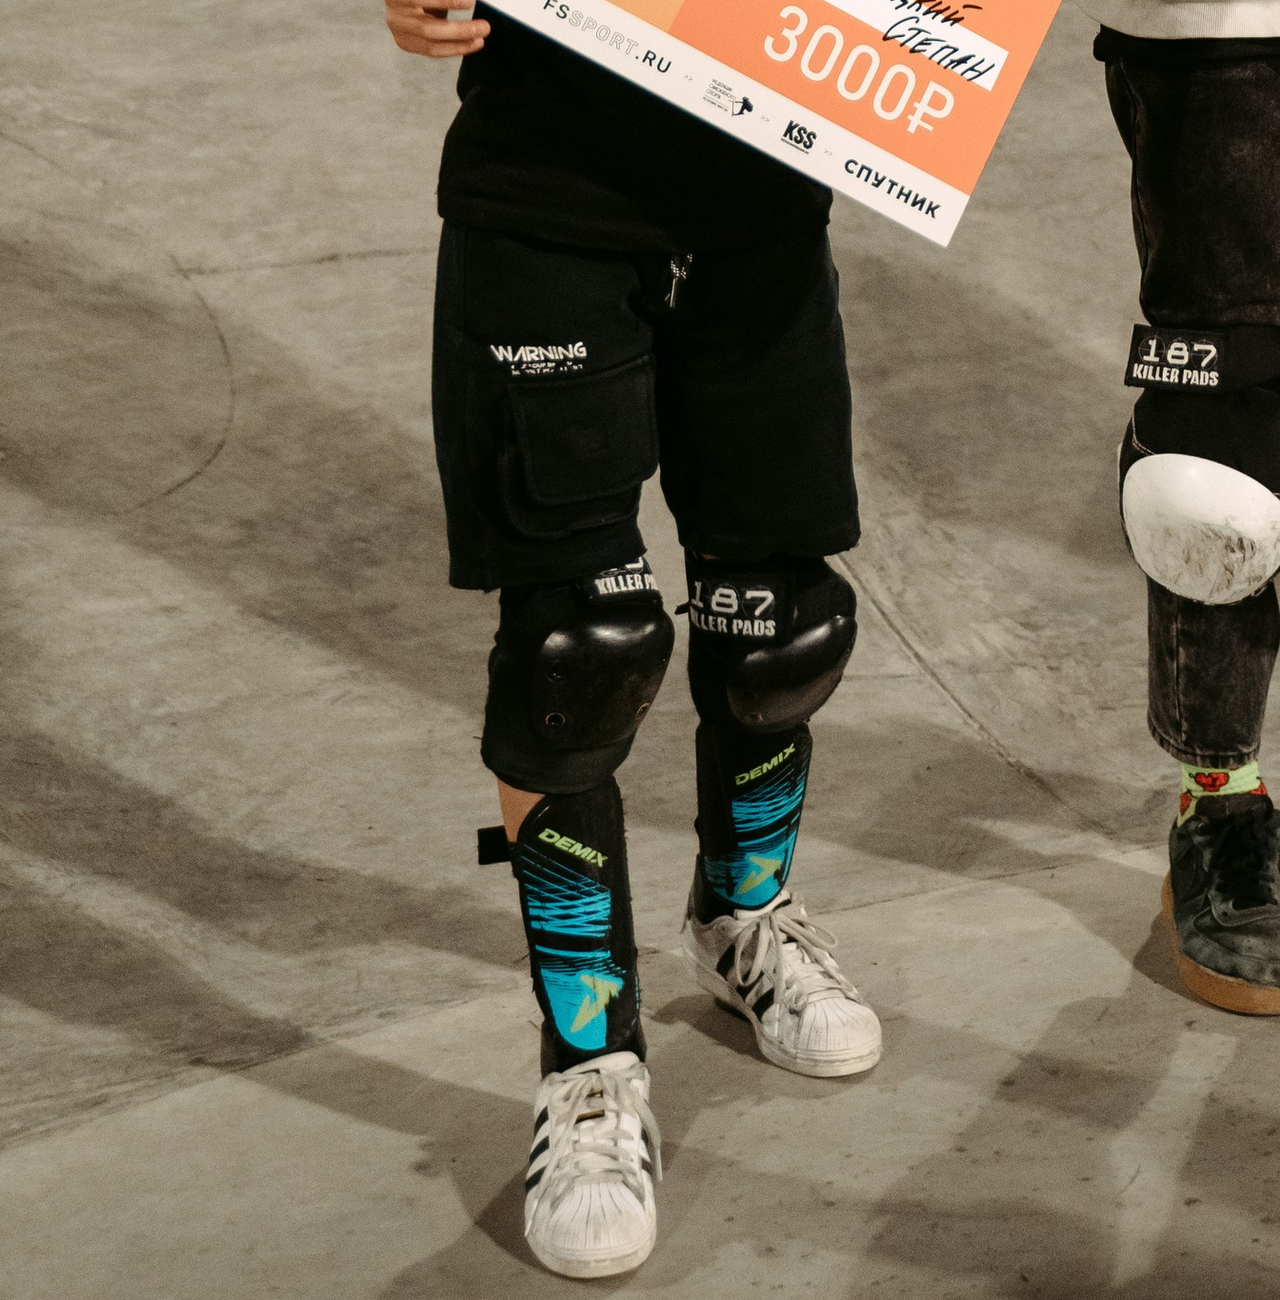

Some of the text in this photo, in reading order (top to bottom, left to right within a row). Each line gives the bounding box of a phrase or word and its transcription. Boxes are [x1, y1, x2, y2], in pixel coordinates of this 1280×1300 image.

[781, 119, 818, 151] KSS
[841, 155, 942, 220] СПУТНИК
[490, 341, 588, 361] WARNING
[1143, 338, 1218, 368] 187
[1132, 362, 1219, 387] KILLER PADS
[594, 574, 643, 594] KILLER
[692, 581, 775, 618] 187
[732, 618, 776, 637] PADS
[735, 743, 796, 786] DEMIX
[538, 827, 609, 868] DEMIX
